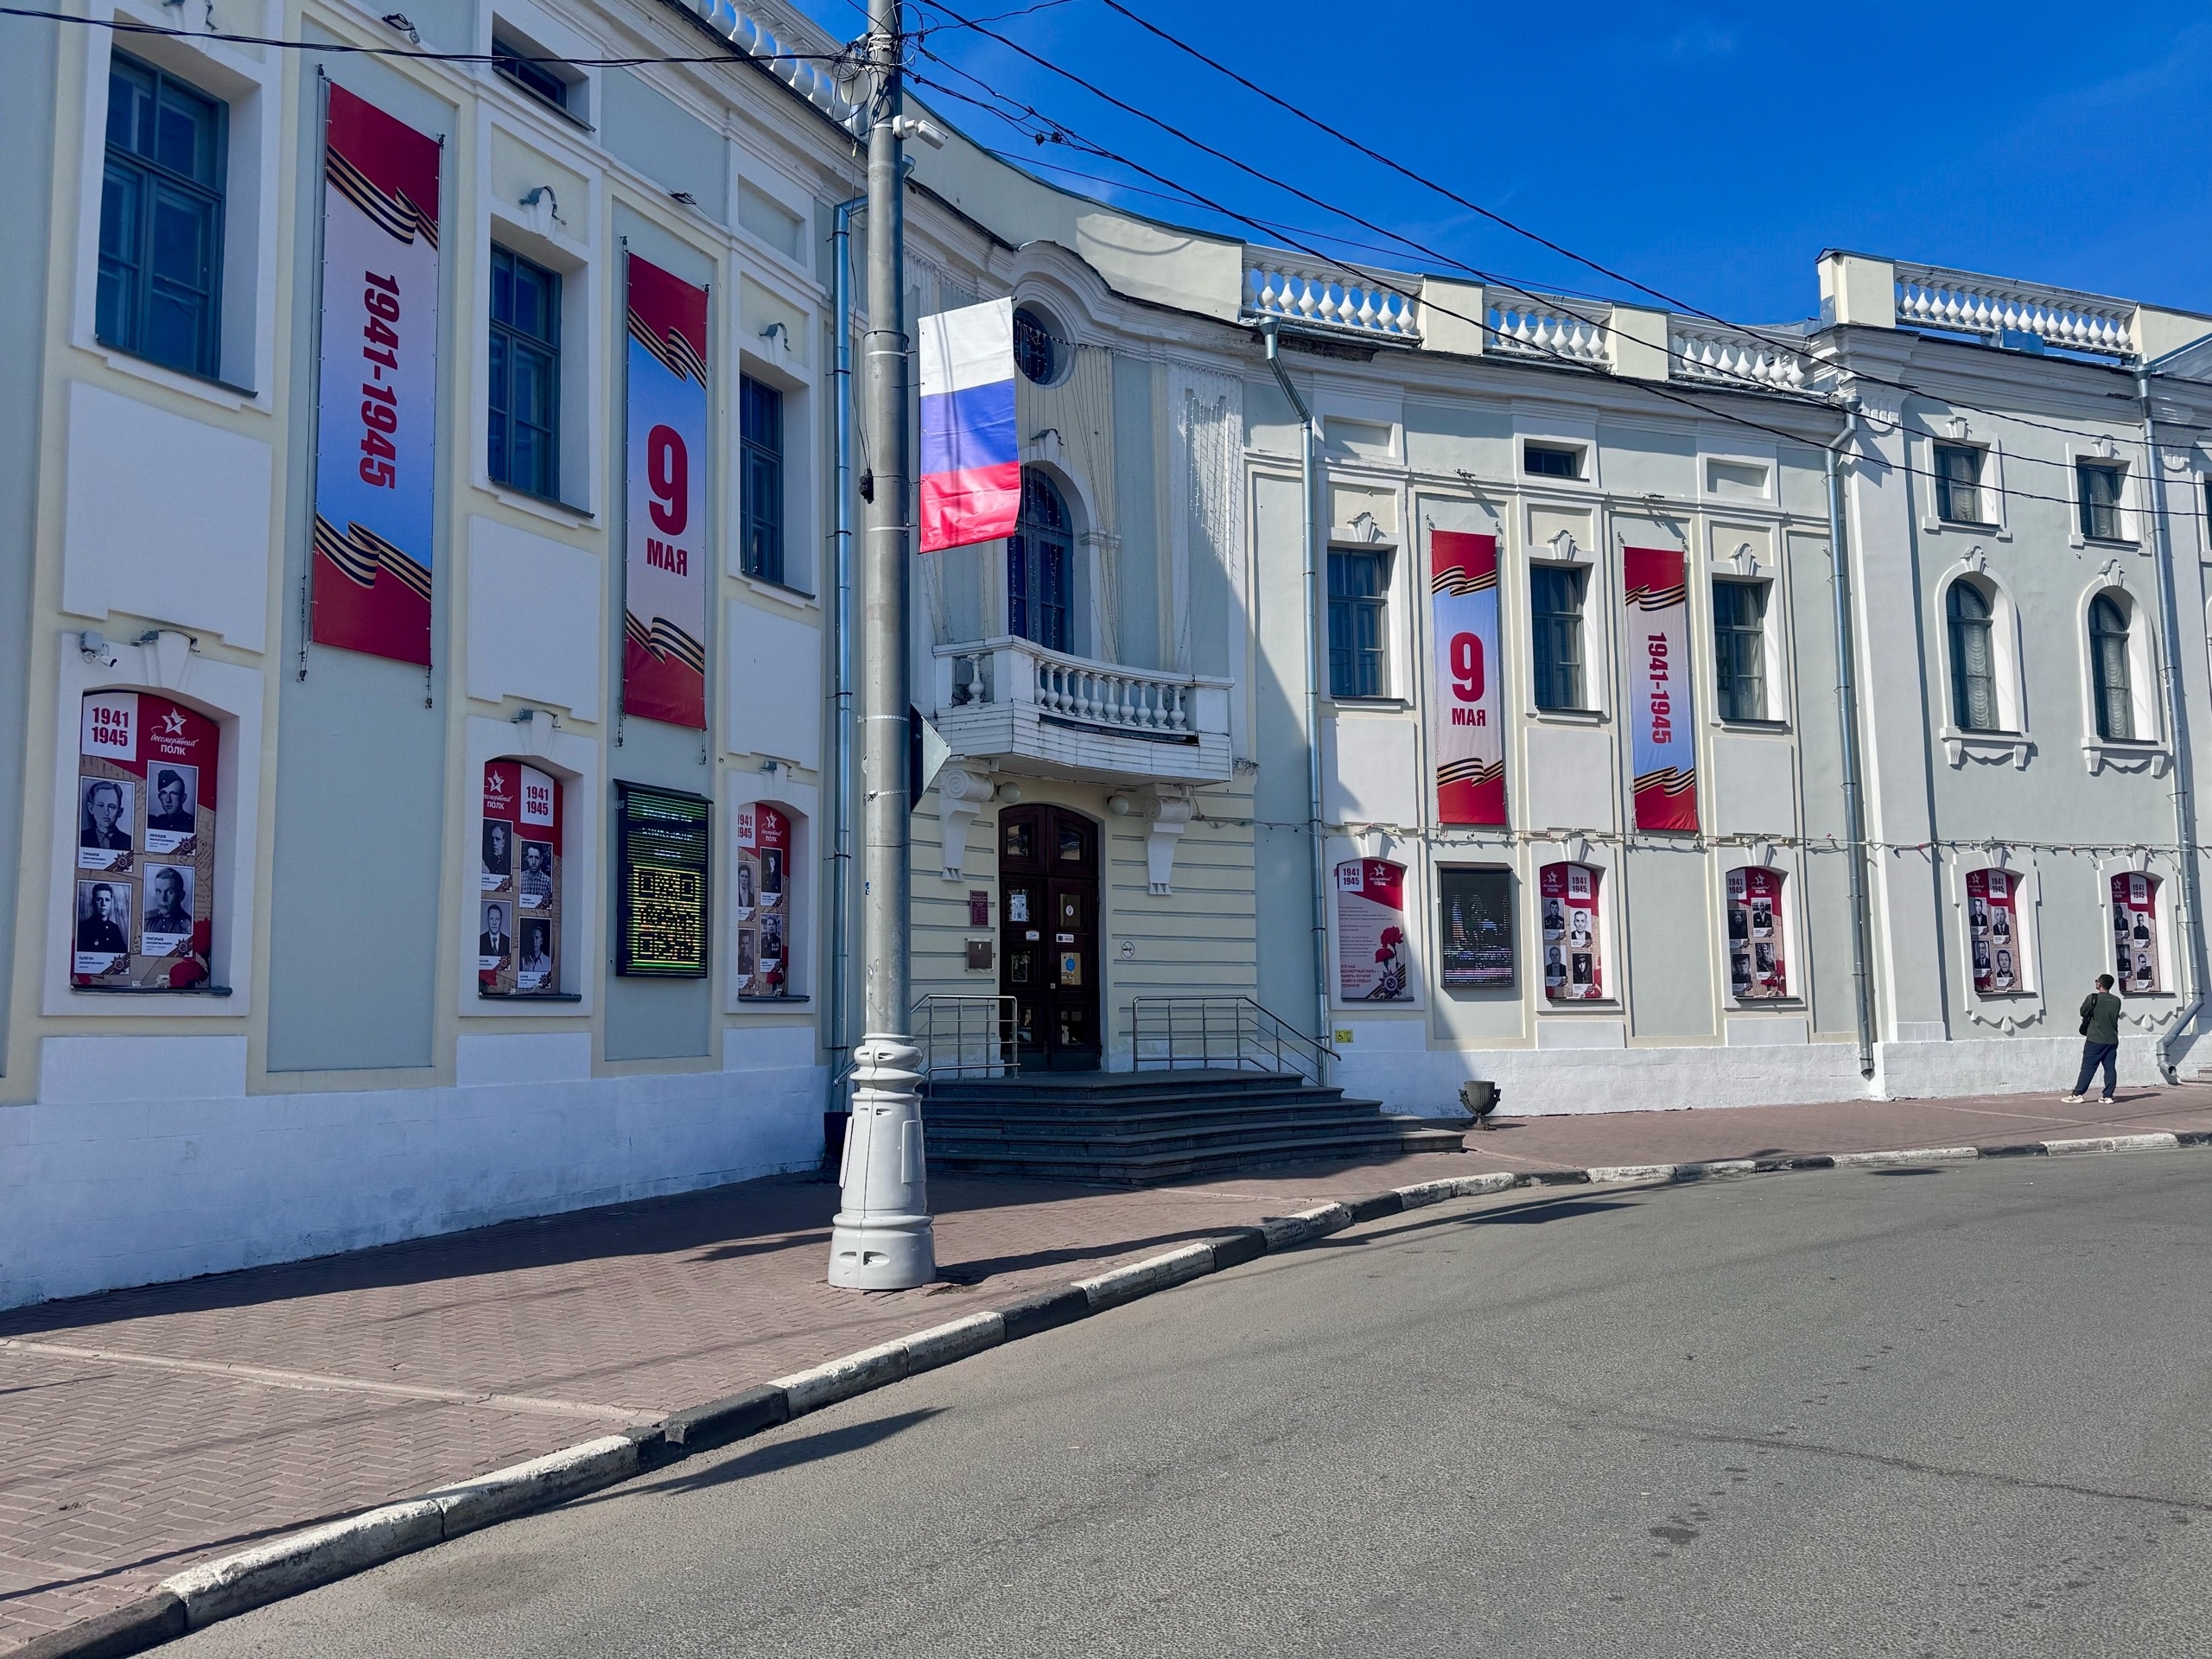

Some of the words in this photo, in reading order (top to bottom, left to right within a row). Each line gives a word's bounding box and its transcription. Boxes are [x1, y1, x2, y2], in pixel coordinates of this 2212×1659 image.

[359, 270, 401, 490] 1941-1945
[647, 423, 689, 537] 9
[646, 537, 688, 577] МАЯ
[1449, 632, 1486, 703] 9
[1647, 631, 1674, 745] 1941-1945
[92, 707, 129, 728] 1941
[1451, 707, 1487, 728] МАЯ
[91, 726, 129, 747] 1945
[161, 744, 186, 756] ПОЛК
[526, 785, 549, 801] 1941
[486, 801, 505, 810] ПОЛК
[525, 800, 549, 816] 1945
[1343, 868, 1360, 877] 1941
[1572, 876, 1587, 885] 1941
[1343, 876, 1360, 886] 1945
[1572, 885, 1587, 893] 1945
[1992, 885, 2005, 893] 1945
[1729, 886, 1744, 894] 1945
